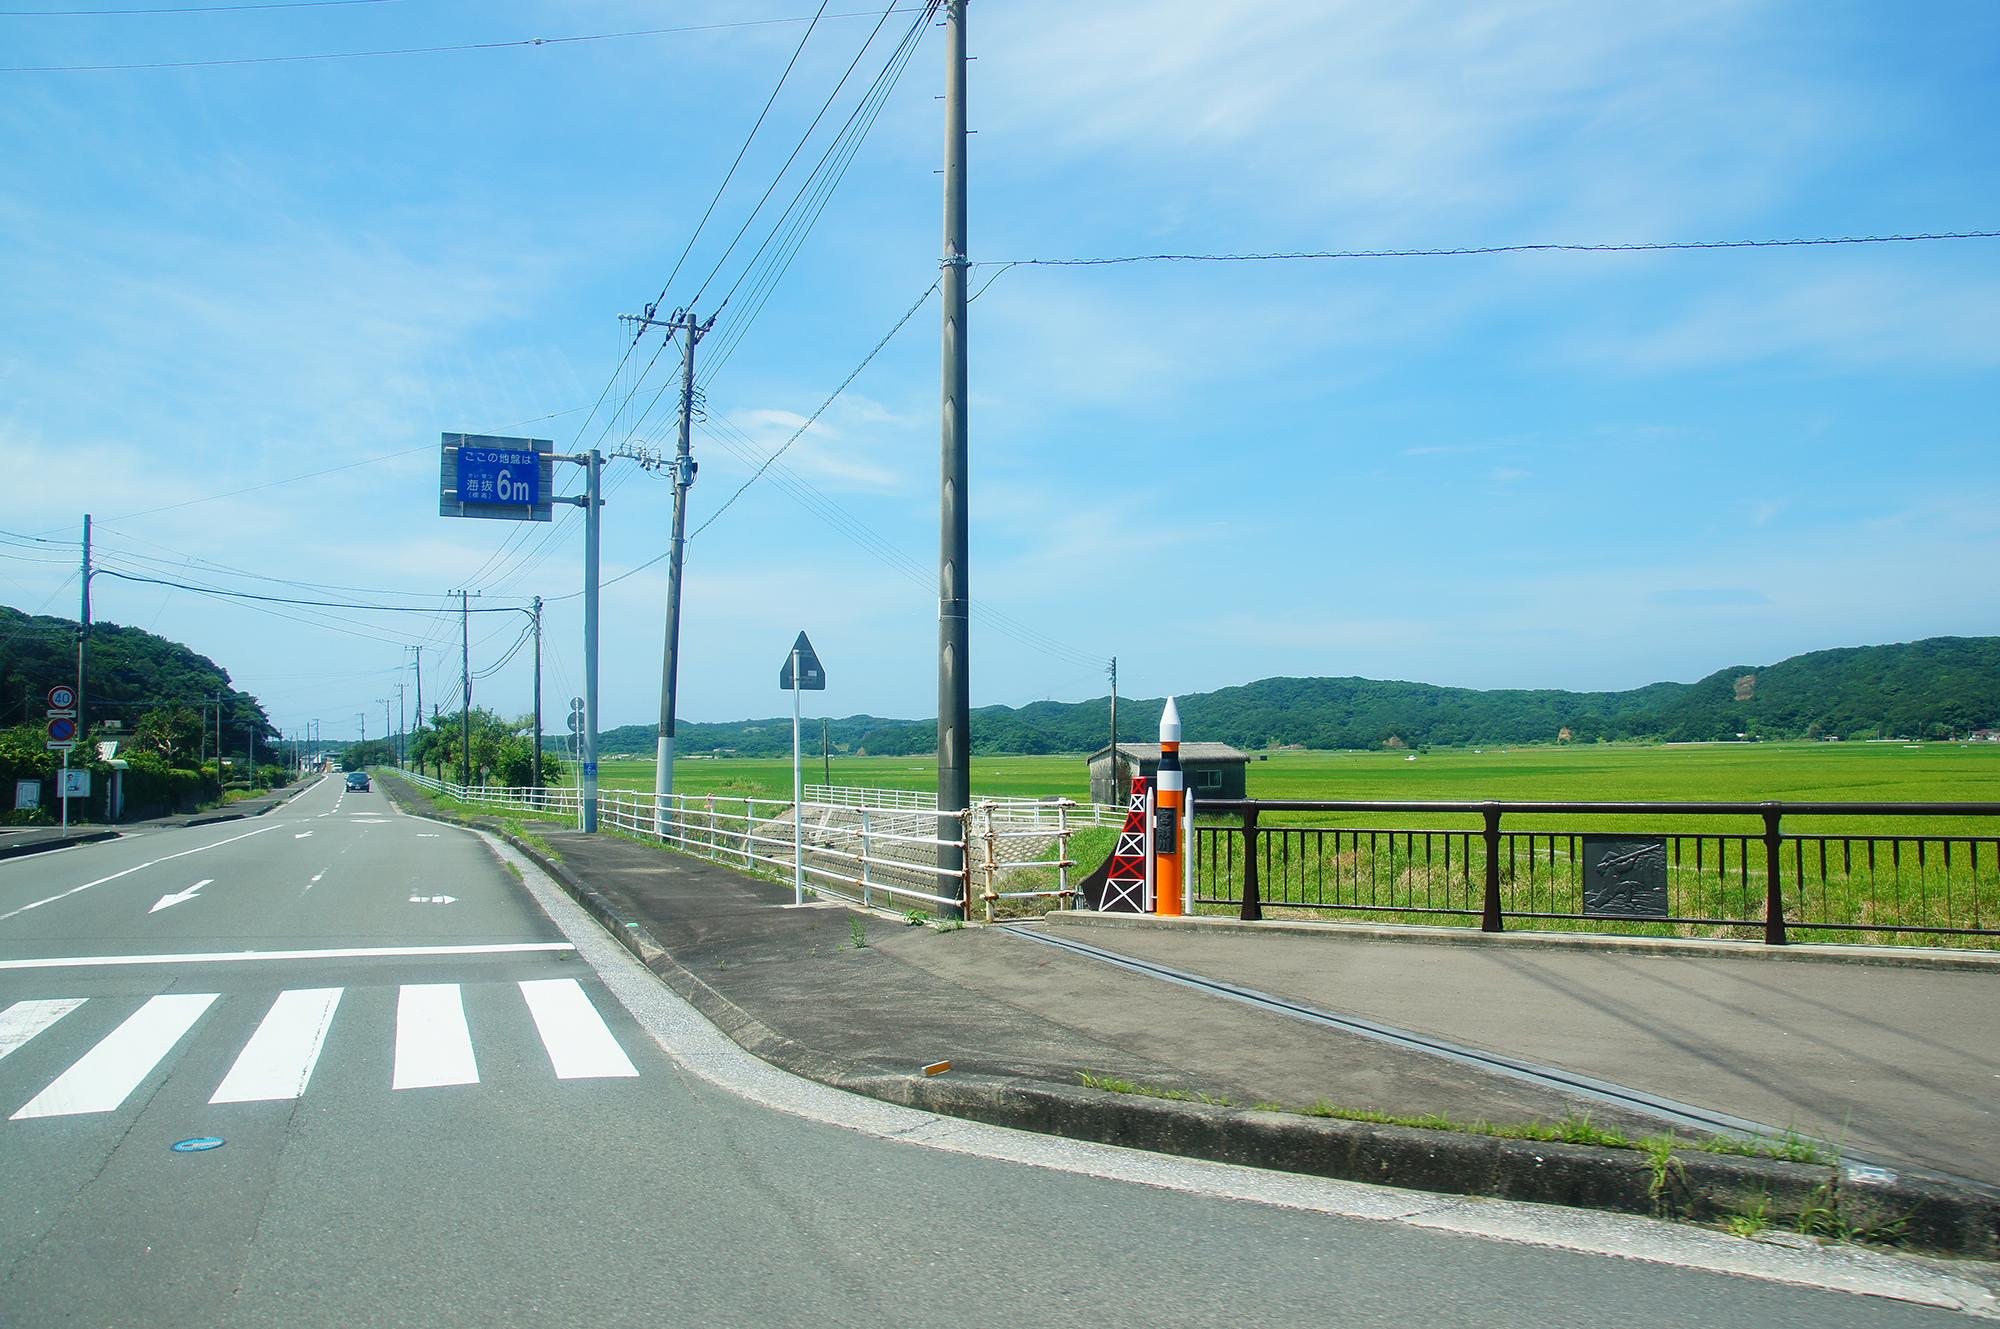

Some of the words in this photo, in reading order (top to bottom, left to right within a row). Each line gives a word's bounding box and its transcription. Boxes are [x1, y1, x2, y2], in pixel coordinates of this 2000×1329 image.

[465, 452, 532, 464] ここの地盤は
[497, 469, 530, 501] 6m
[55, 693, 70, 704] 40
